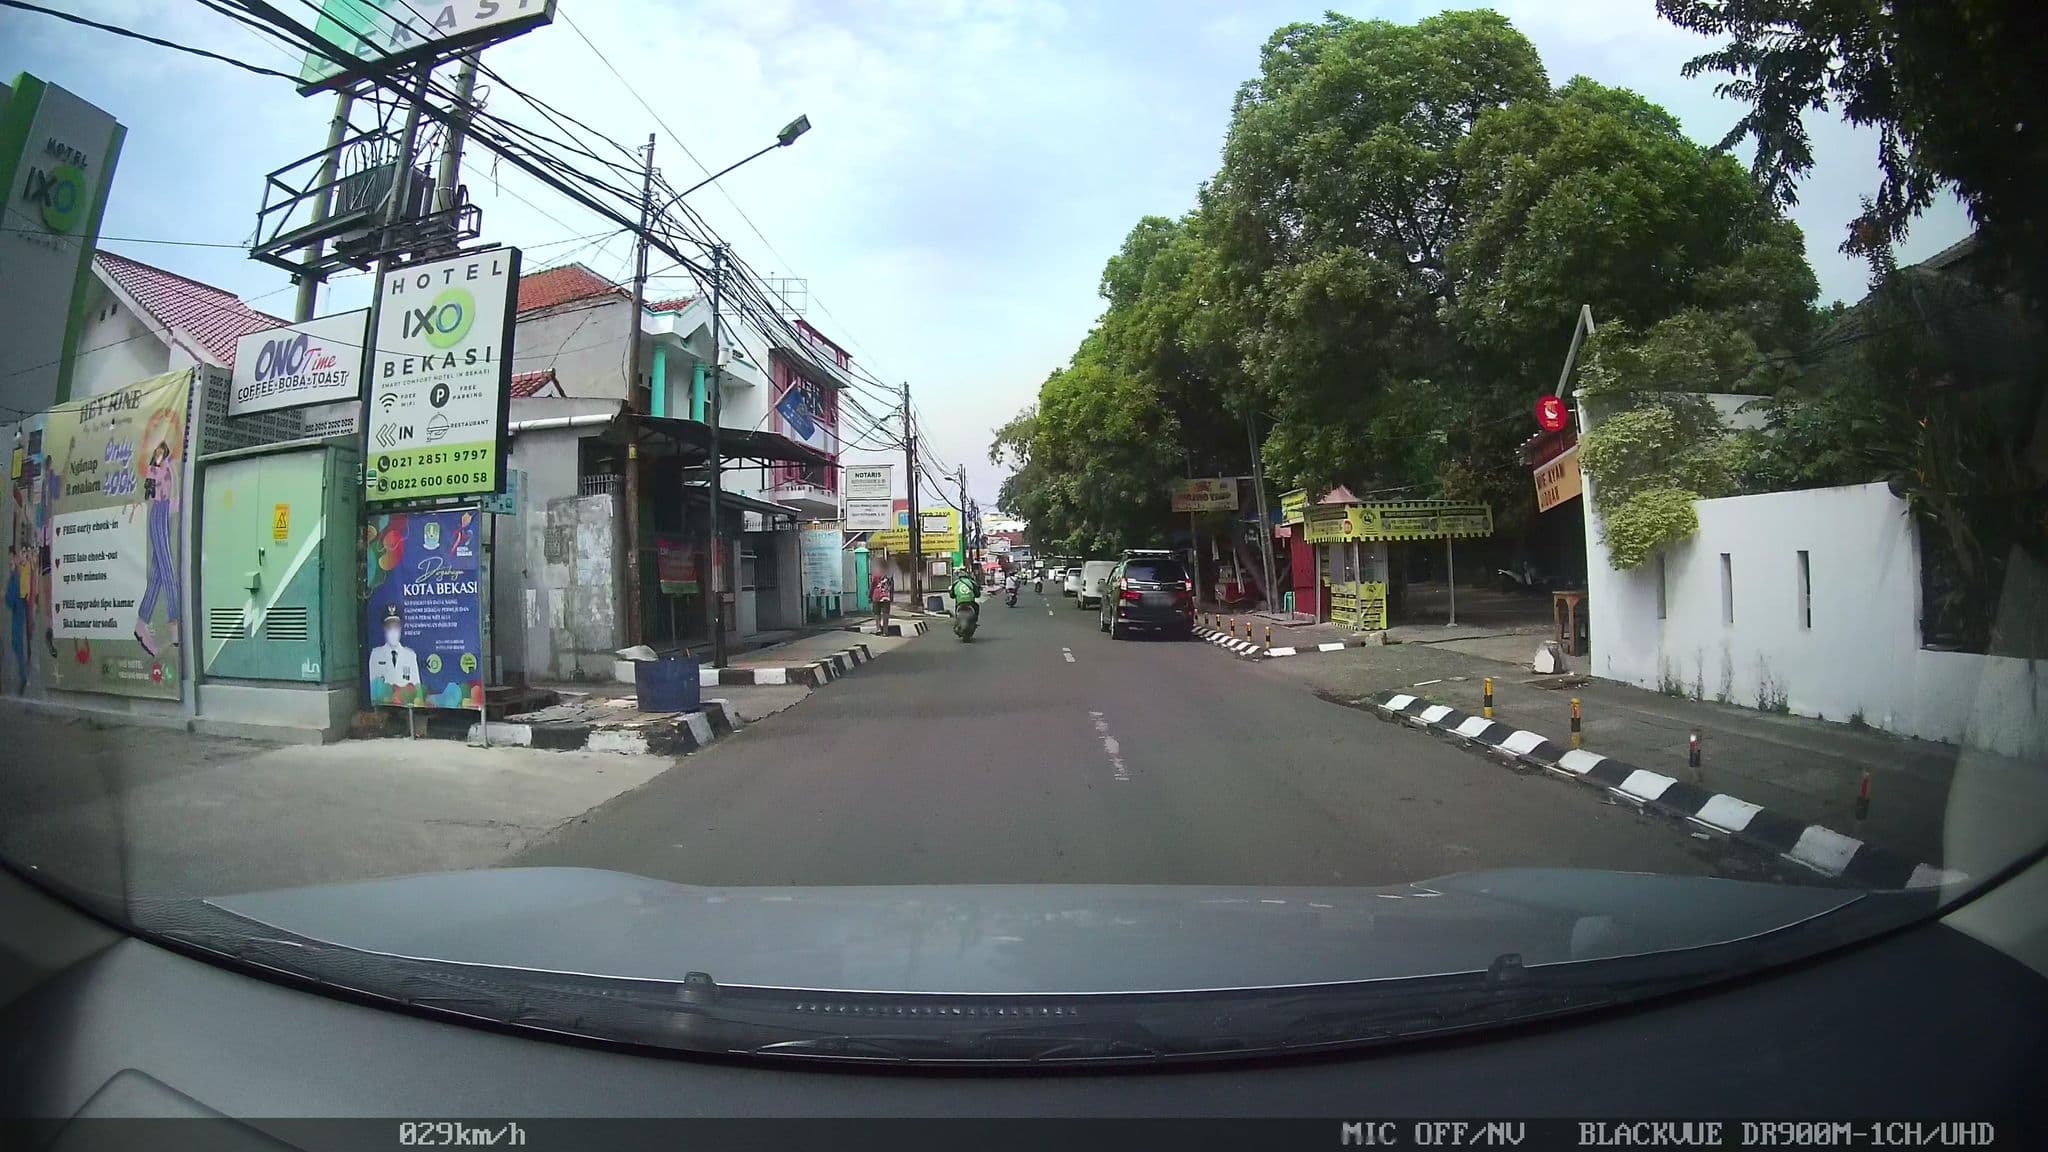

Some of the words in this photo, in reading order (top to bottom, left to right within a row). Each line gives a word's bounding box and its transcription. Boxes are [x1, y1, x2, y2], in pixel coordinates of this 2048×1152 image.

[46, 137, 88, 167] HOTEL
[392, 260, 502, 295] HOTEL
[403, 303, 463, 339] IXO
[254, 333, 310, 382] ONO
[301, 348, 337, 374] Time
[384, 346, 492, 379] BEKASI
[311, 371, 349, 387] TOAST
[399, 425, 414, 440] IN
[391, 456, 412, 468] 021
[418, 453, 447, 465] 2851
[454, 449, 487, 462] 9797
[390, 478, 417, 490] 0822
[421, 475, 443, 487] 600
[446, 473, 469, 485] 600
[473, 472, 487, 483] 58
[63, 524, 77, 535] FREE
[403, 583, 434, 596] KOTA
[436, 581, 478, 595] BEKASI
